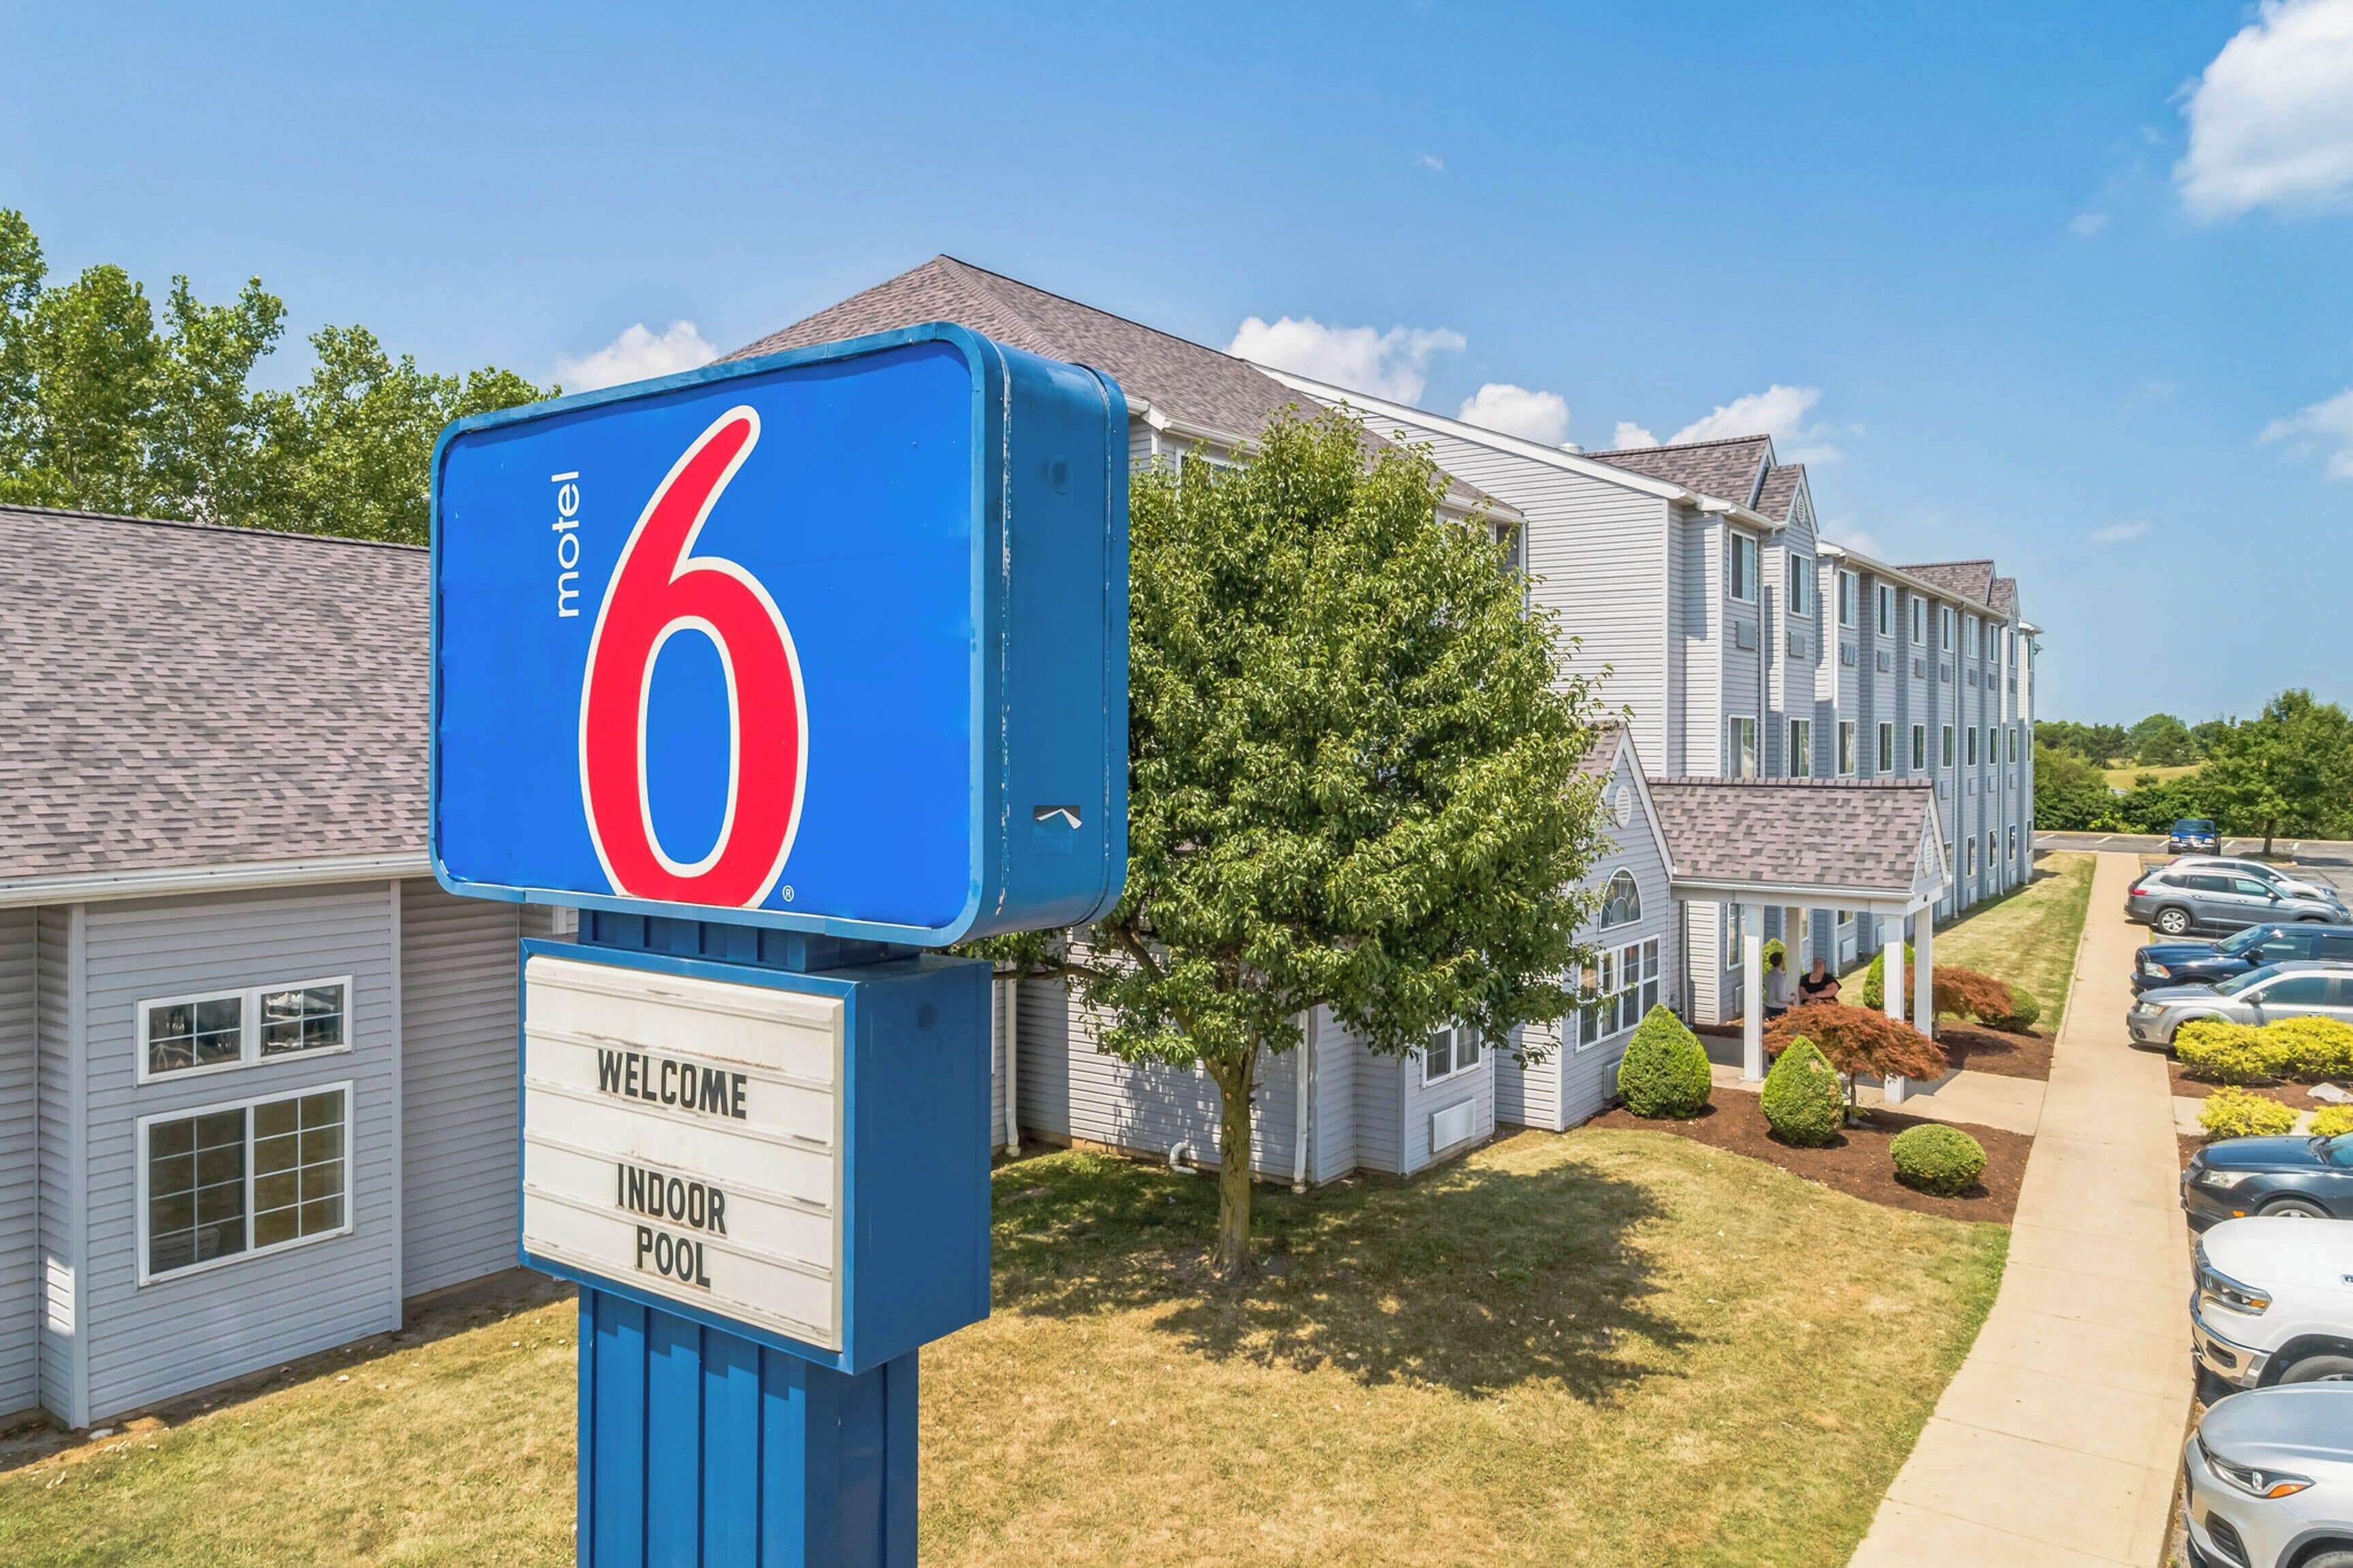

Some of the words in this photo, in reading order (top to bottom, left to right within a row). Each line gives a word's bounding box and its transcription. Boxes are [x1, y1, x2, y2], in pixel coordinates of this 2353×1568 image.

[551, 471, 580, 618] motel
[579, 404, 809, 907] 6
[598, 1049, 747, 1119] WELCOME
[618, 1163, 726, 1234] INDOOR
[637, 1224, 711, 1288] POOL
